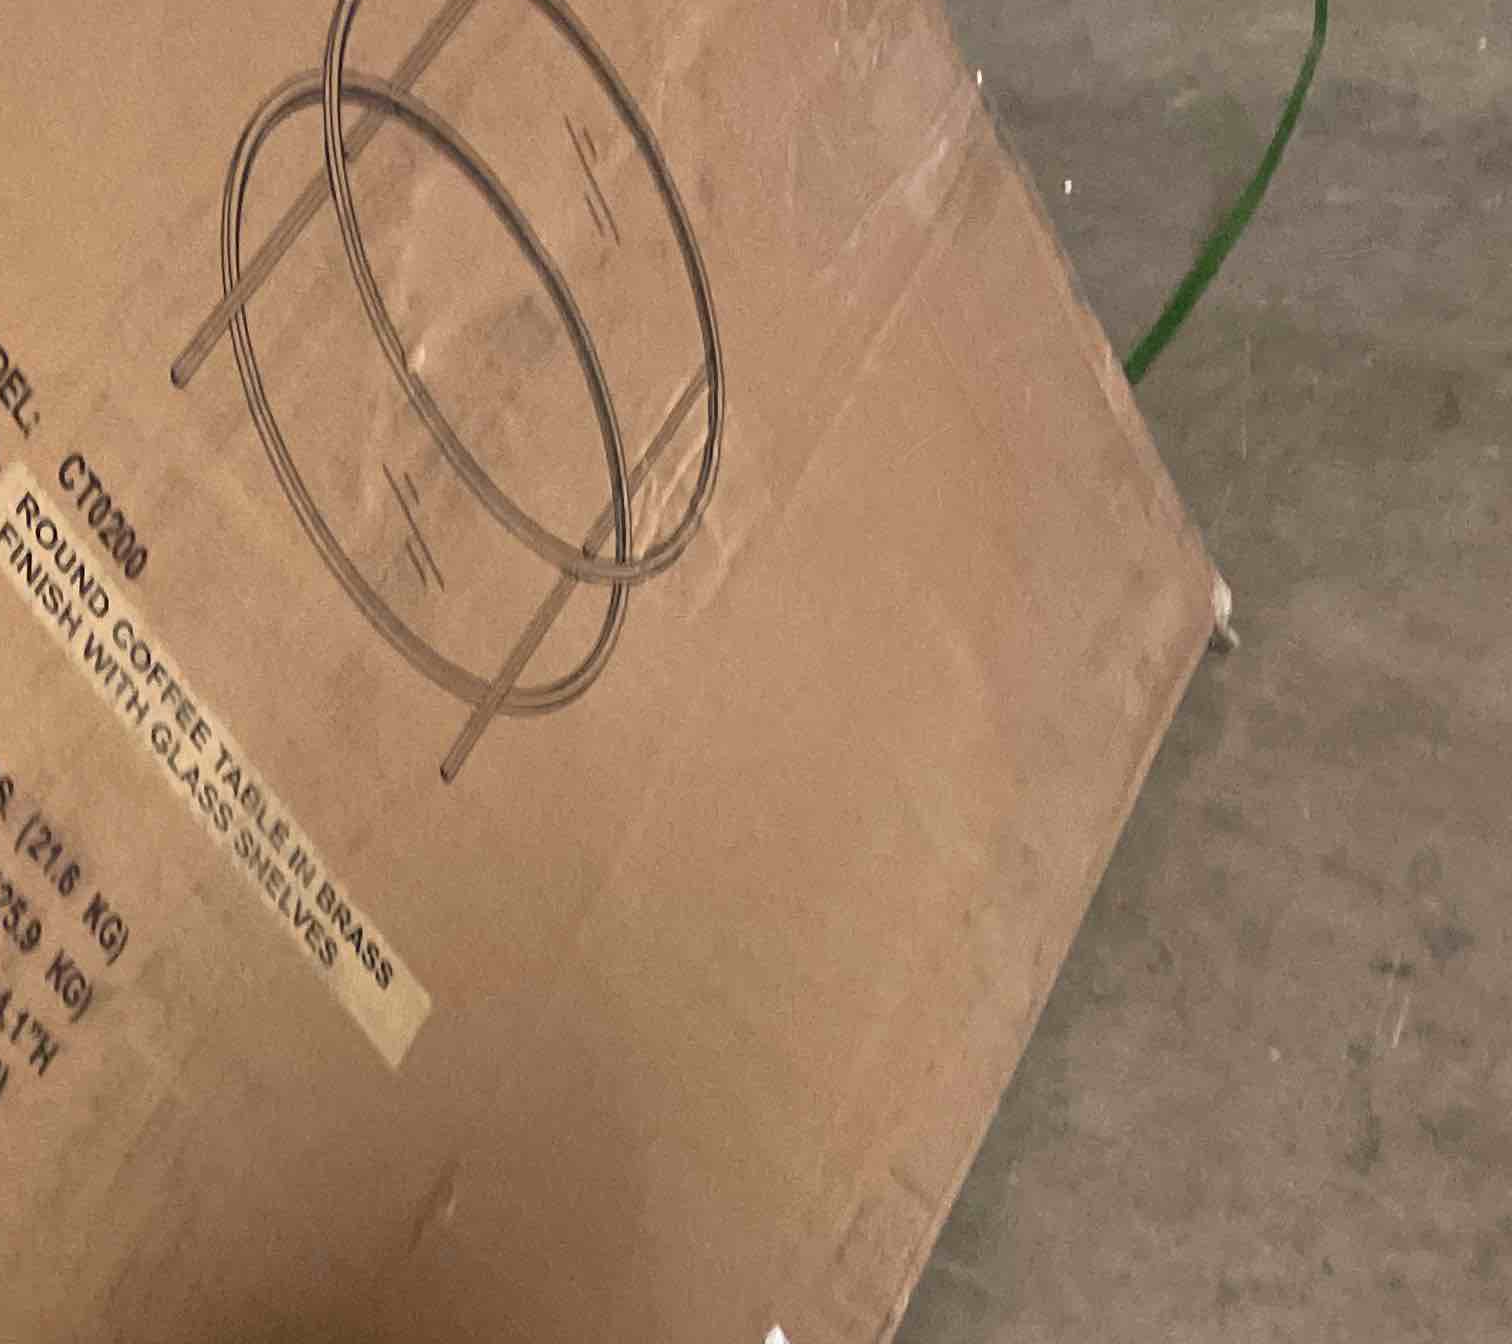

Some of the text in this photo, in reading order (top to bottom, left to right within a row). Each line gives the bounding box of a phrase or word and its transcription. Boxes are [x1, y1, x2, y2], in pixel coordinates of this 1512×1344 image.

[57, 451, 149, 581] CT0200
[14, 489, 394, 990] ROUND COFFEE TABLE IN BRASS
[82, 630, 150, 726] WITH
[149, 721, 234, 834] GLASS
[233, 828, 339, 971] SHELVES
[13, 811, 81, 897] (21.6
[81, 890, 129, 967] KG)
[43, 948, 96, 1024] KG)
